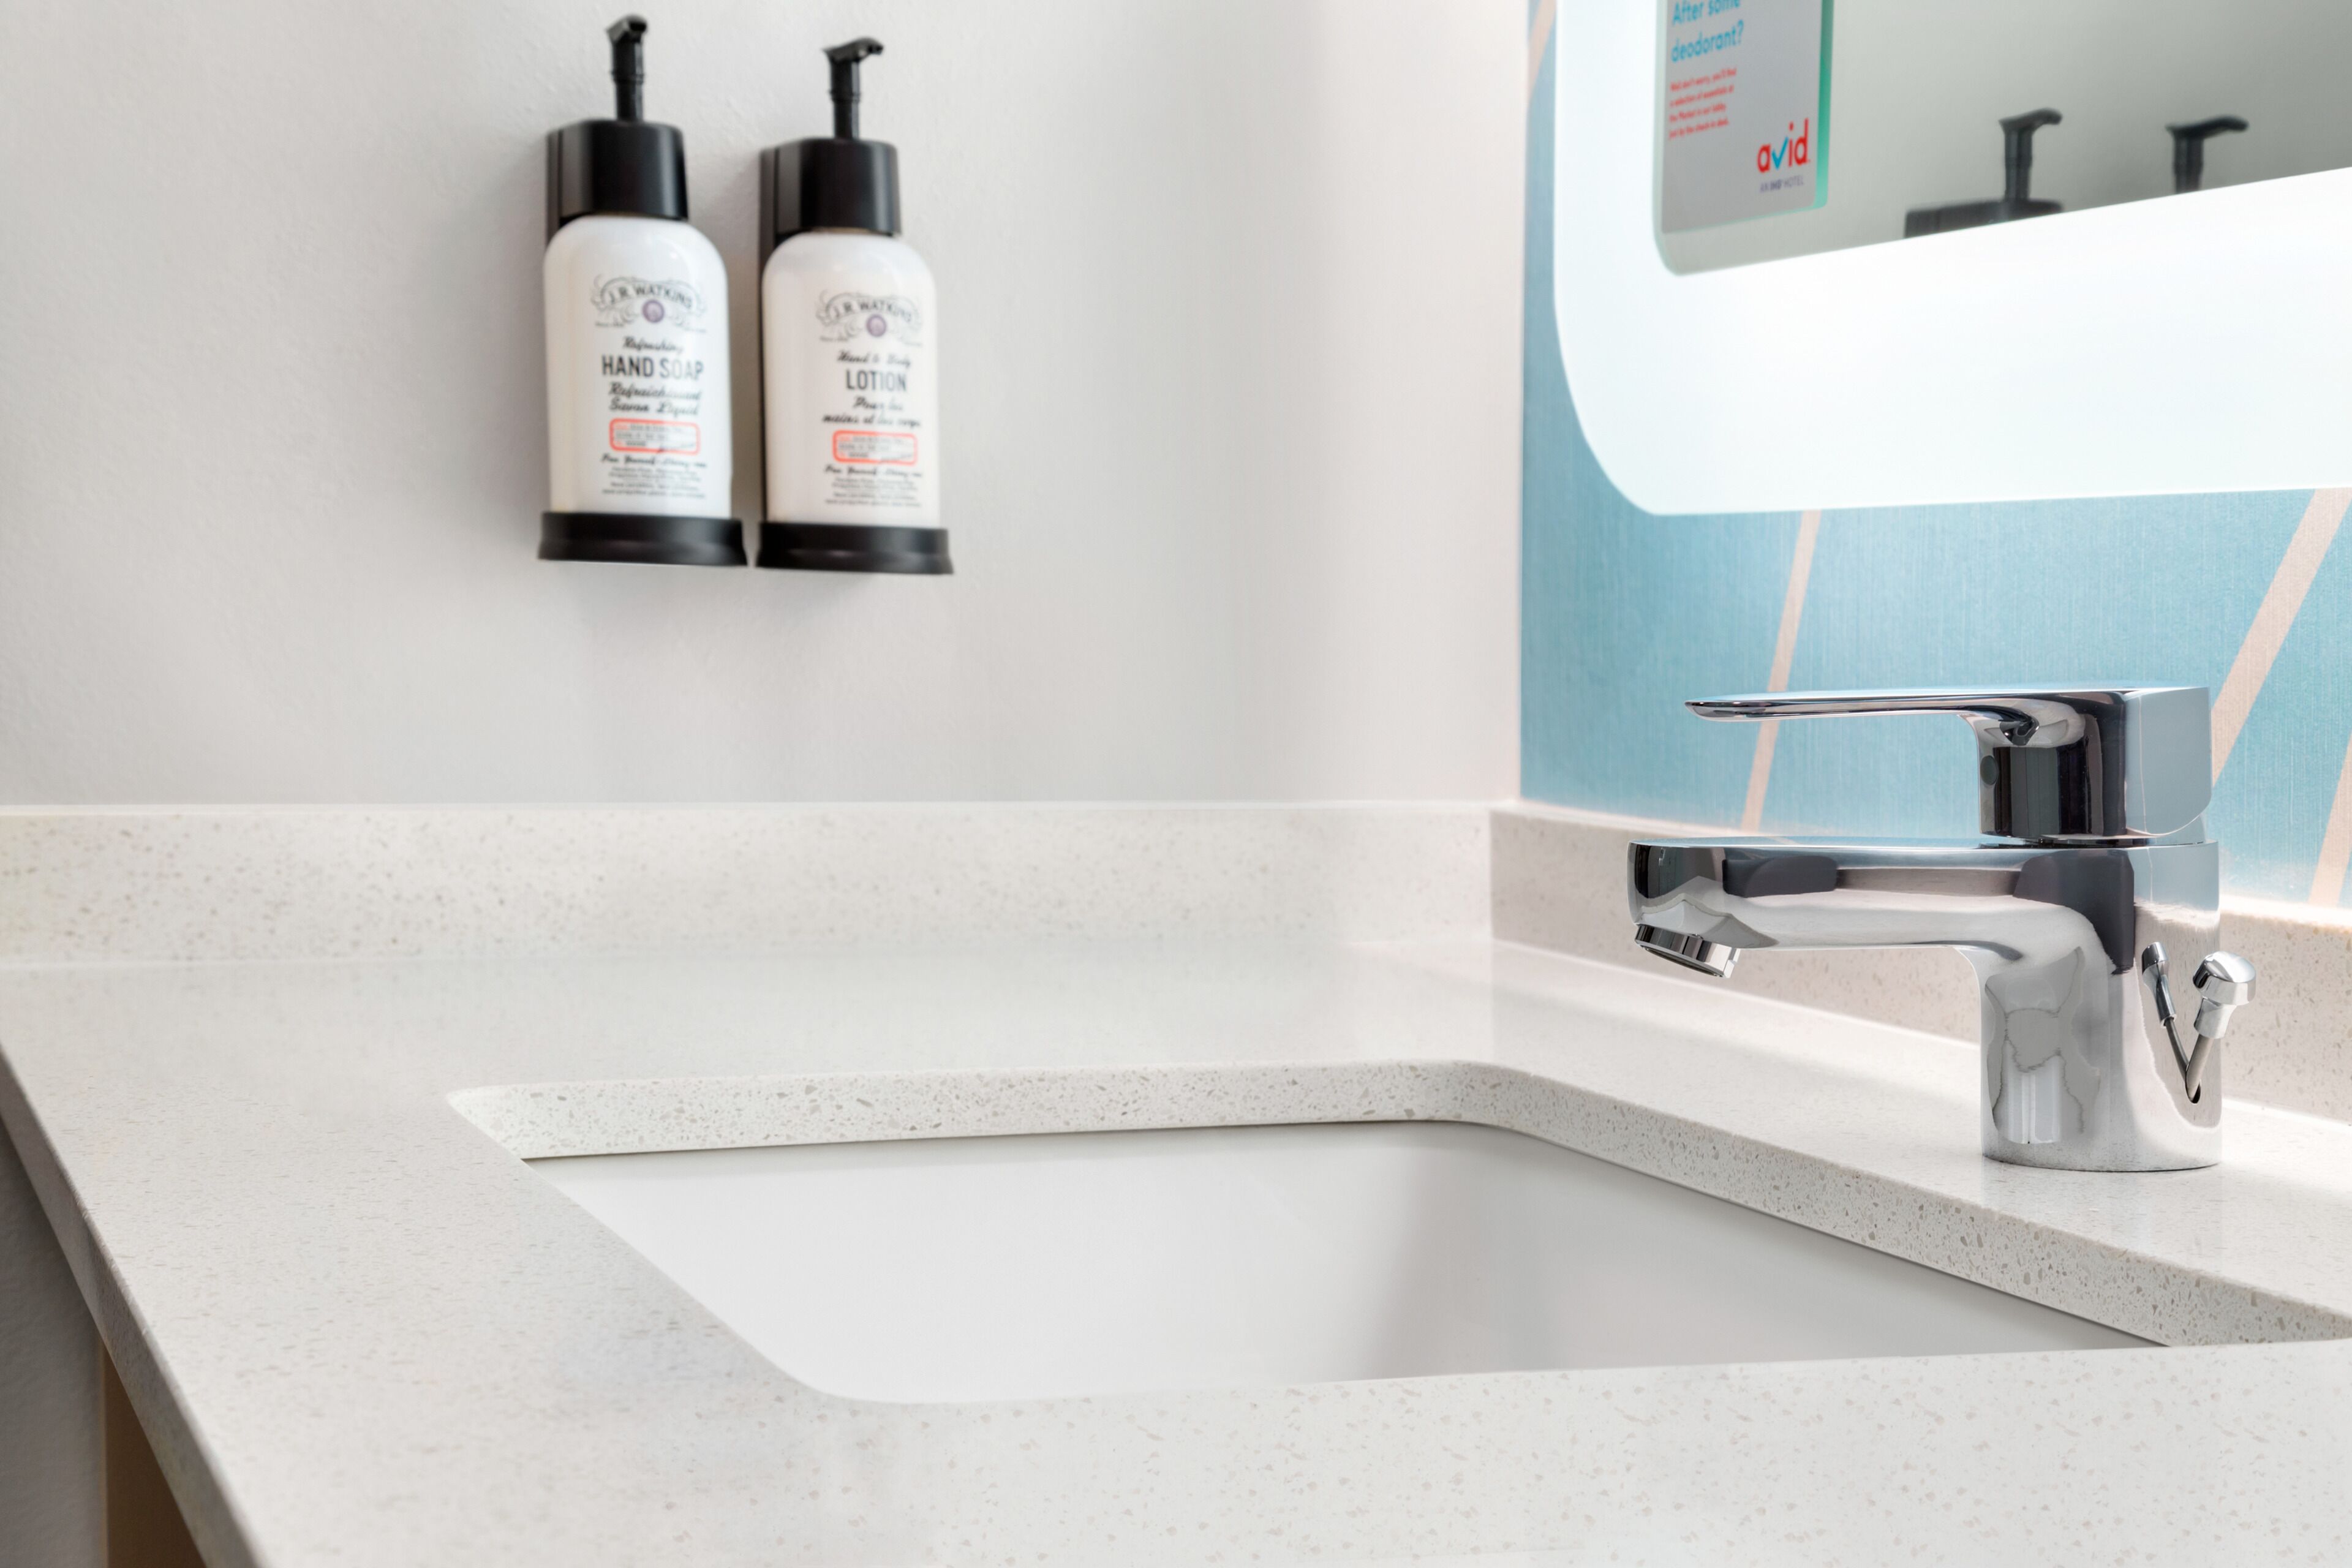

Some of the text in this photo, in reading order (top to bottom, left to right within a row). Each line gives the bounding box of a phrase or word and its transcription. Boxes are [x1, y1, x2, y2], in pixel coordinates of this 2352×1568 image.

[1672, 0, 1703, 25] After
[1671, 19, 1744, 62] deodorant?
[1757, 117, 1809, 173] avid
[1784, 175, 1804, 189] HOTEL
[633, 284, 693, 309] WATKINS
[859, 299, 913, 323] WATKINS
[601, 355, 705, 381] HAND SOAP
[845, 369, 907, 392] LOTION
